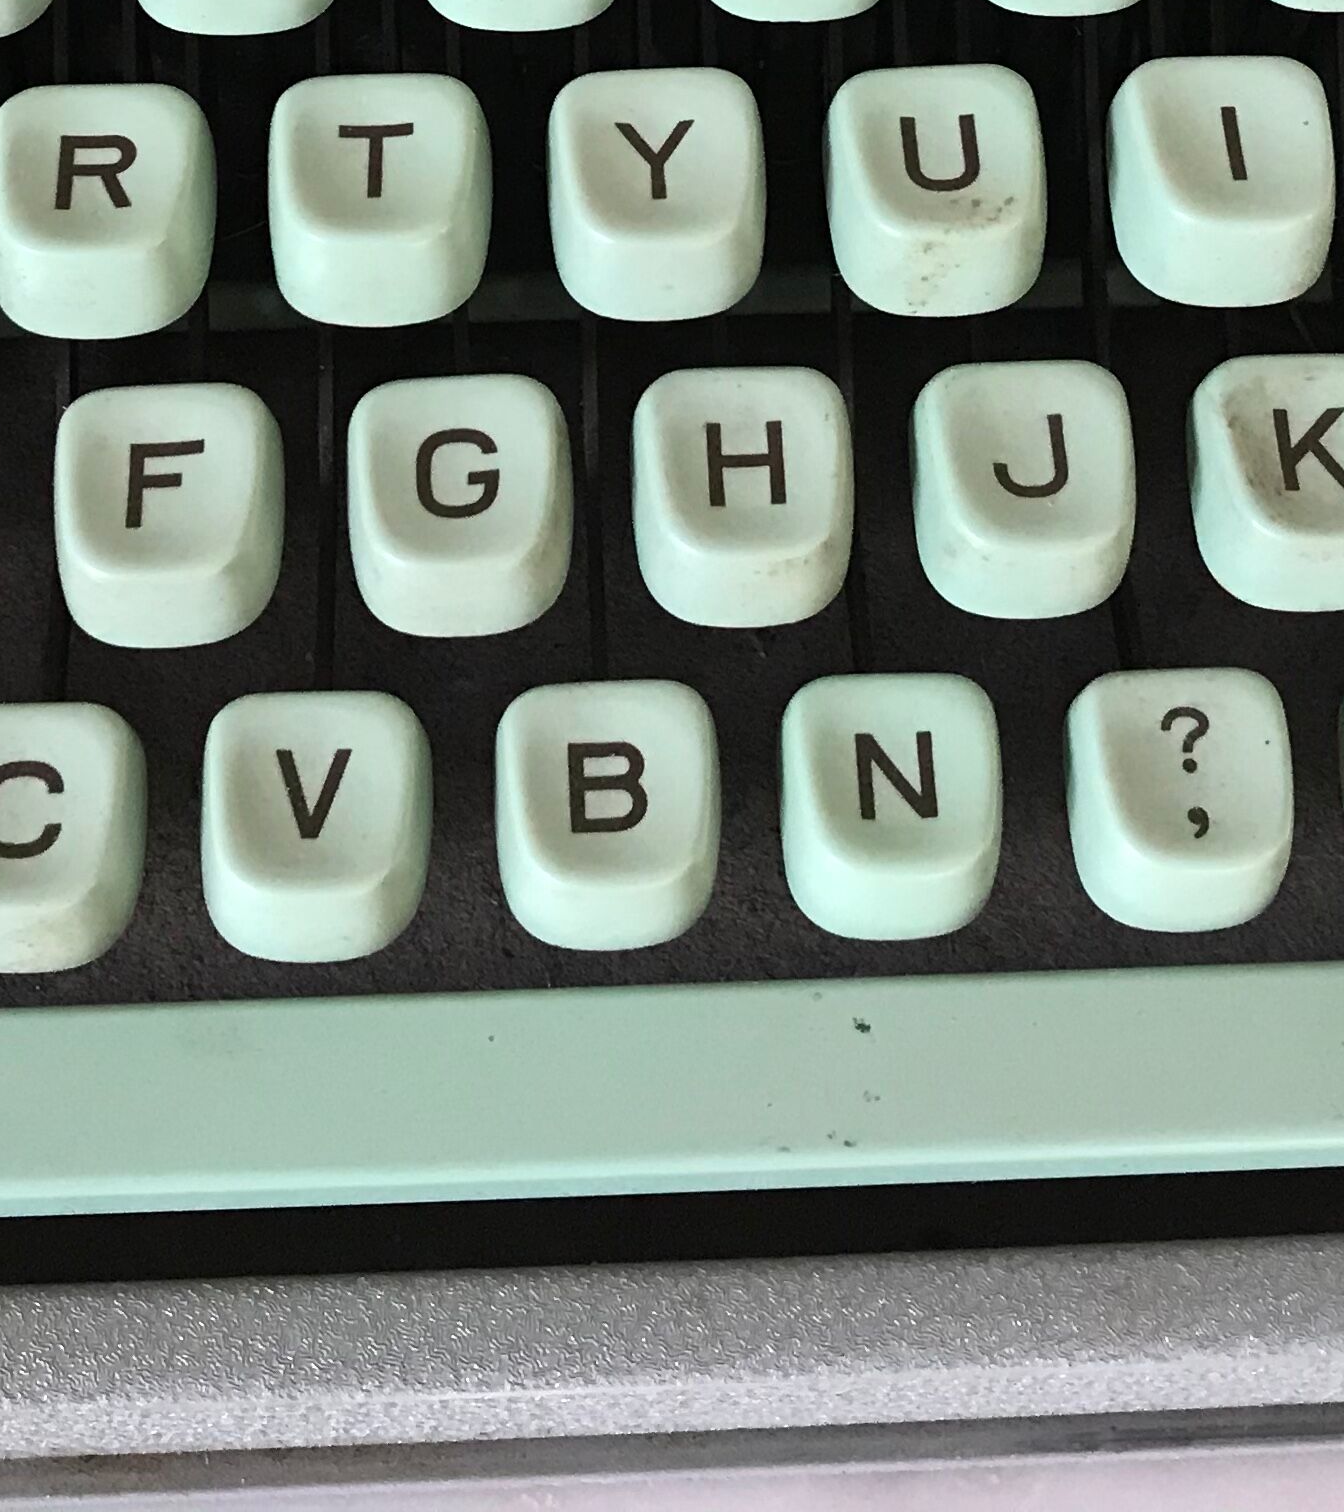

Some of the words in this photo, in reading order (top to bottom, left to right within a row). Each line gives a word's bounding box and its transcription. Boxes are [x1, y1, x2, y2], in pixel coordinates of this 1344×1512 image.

[53, 134, 137, 211] R
[337, 122, 414, 199] T
[614, 119, 695, 201] Y
[899, 113, 981, 193] U
[1220, 106, 1249, 182] I
[124, 438, 205, 530] F
[415, 428, 500, 520] G
[705, 420, 787, 508] H
[992, 413, 1069, 499] J
[854, 730, 939, 822] N
[1160, 706, 1210, 774] ?
[275, 748, 353, 840] V
[567, 741, 649, 835] B
